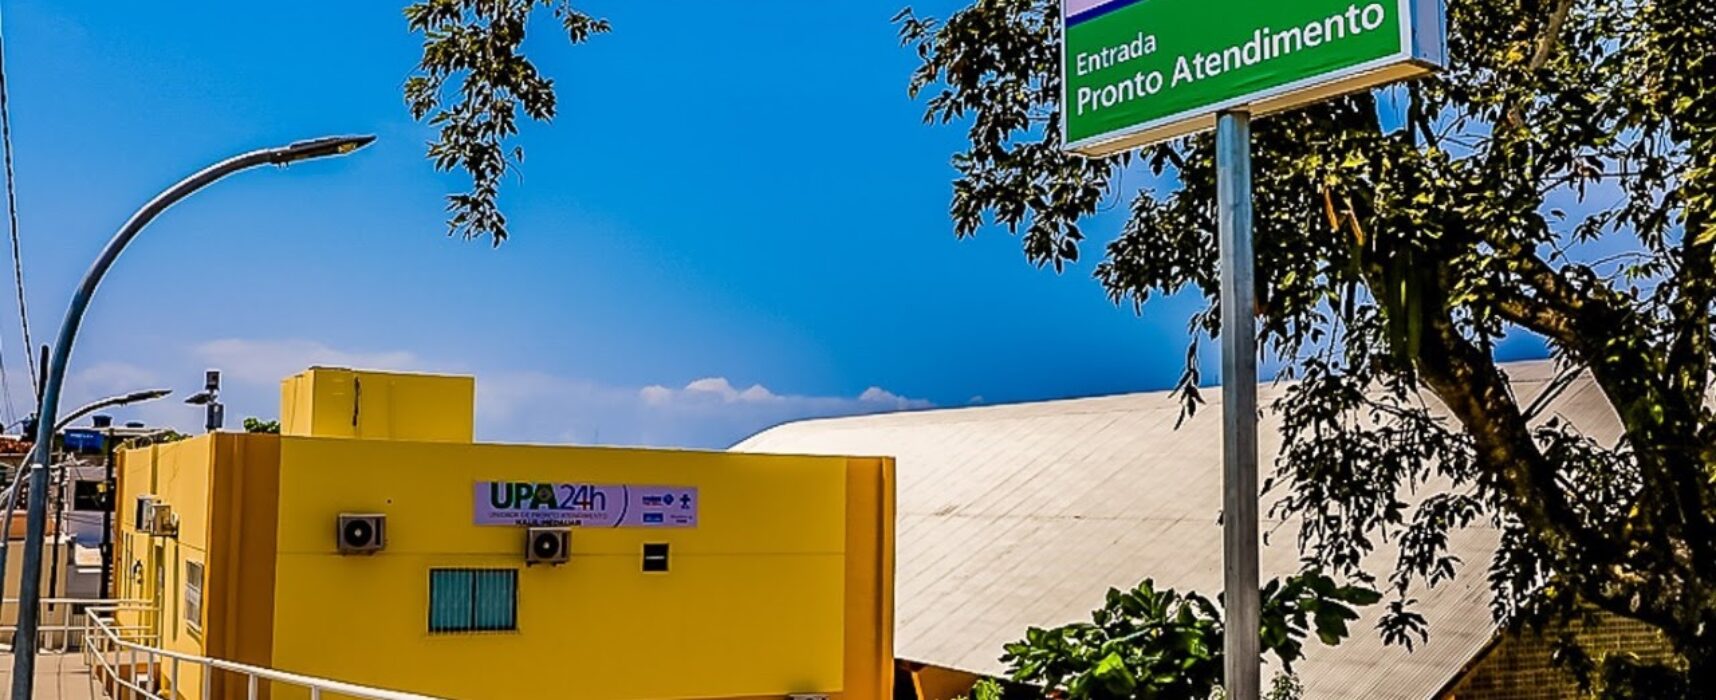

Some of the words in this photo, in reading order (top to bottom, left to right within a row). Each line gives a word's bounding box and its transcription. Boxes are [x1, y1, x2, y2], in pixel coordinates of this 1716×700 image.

[1076, 31, 1157, 76] Entrada
[1076, 69, 1163, 117] Pronto
[1171, 2, 1385, 88] Atendimento
[490, 481, 558, 510] UPA
[559, 483, 606, 511] 24h
